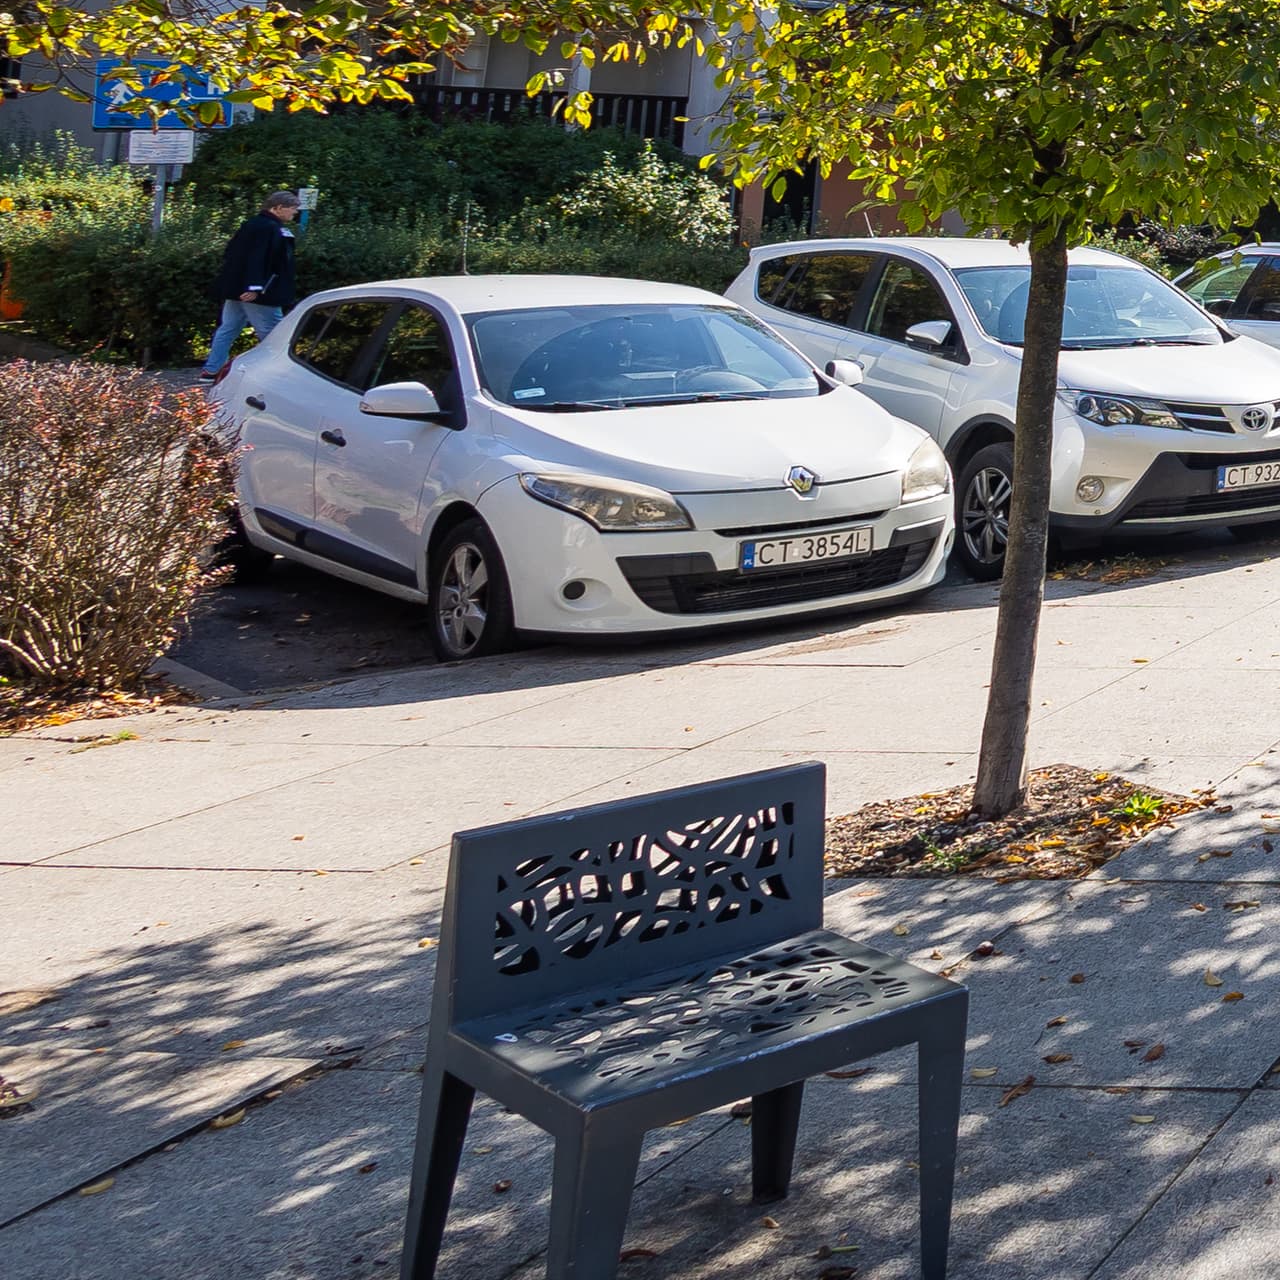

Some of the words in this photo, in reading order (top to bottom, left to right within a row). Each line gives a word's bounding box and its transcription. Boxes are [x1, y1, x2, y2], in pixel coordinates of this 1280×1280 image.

[1228, 467, 1250, 486] CT
[759, 541, 793, 565] CT
[802, 531, 867, 560] 3854L
